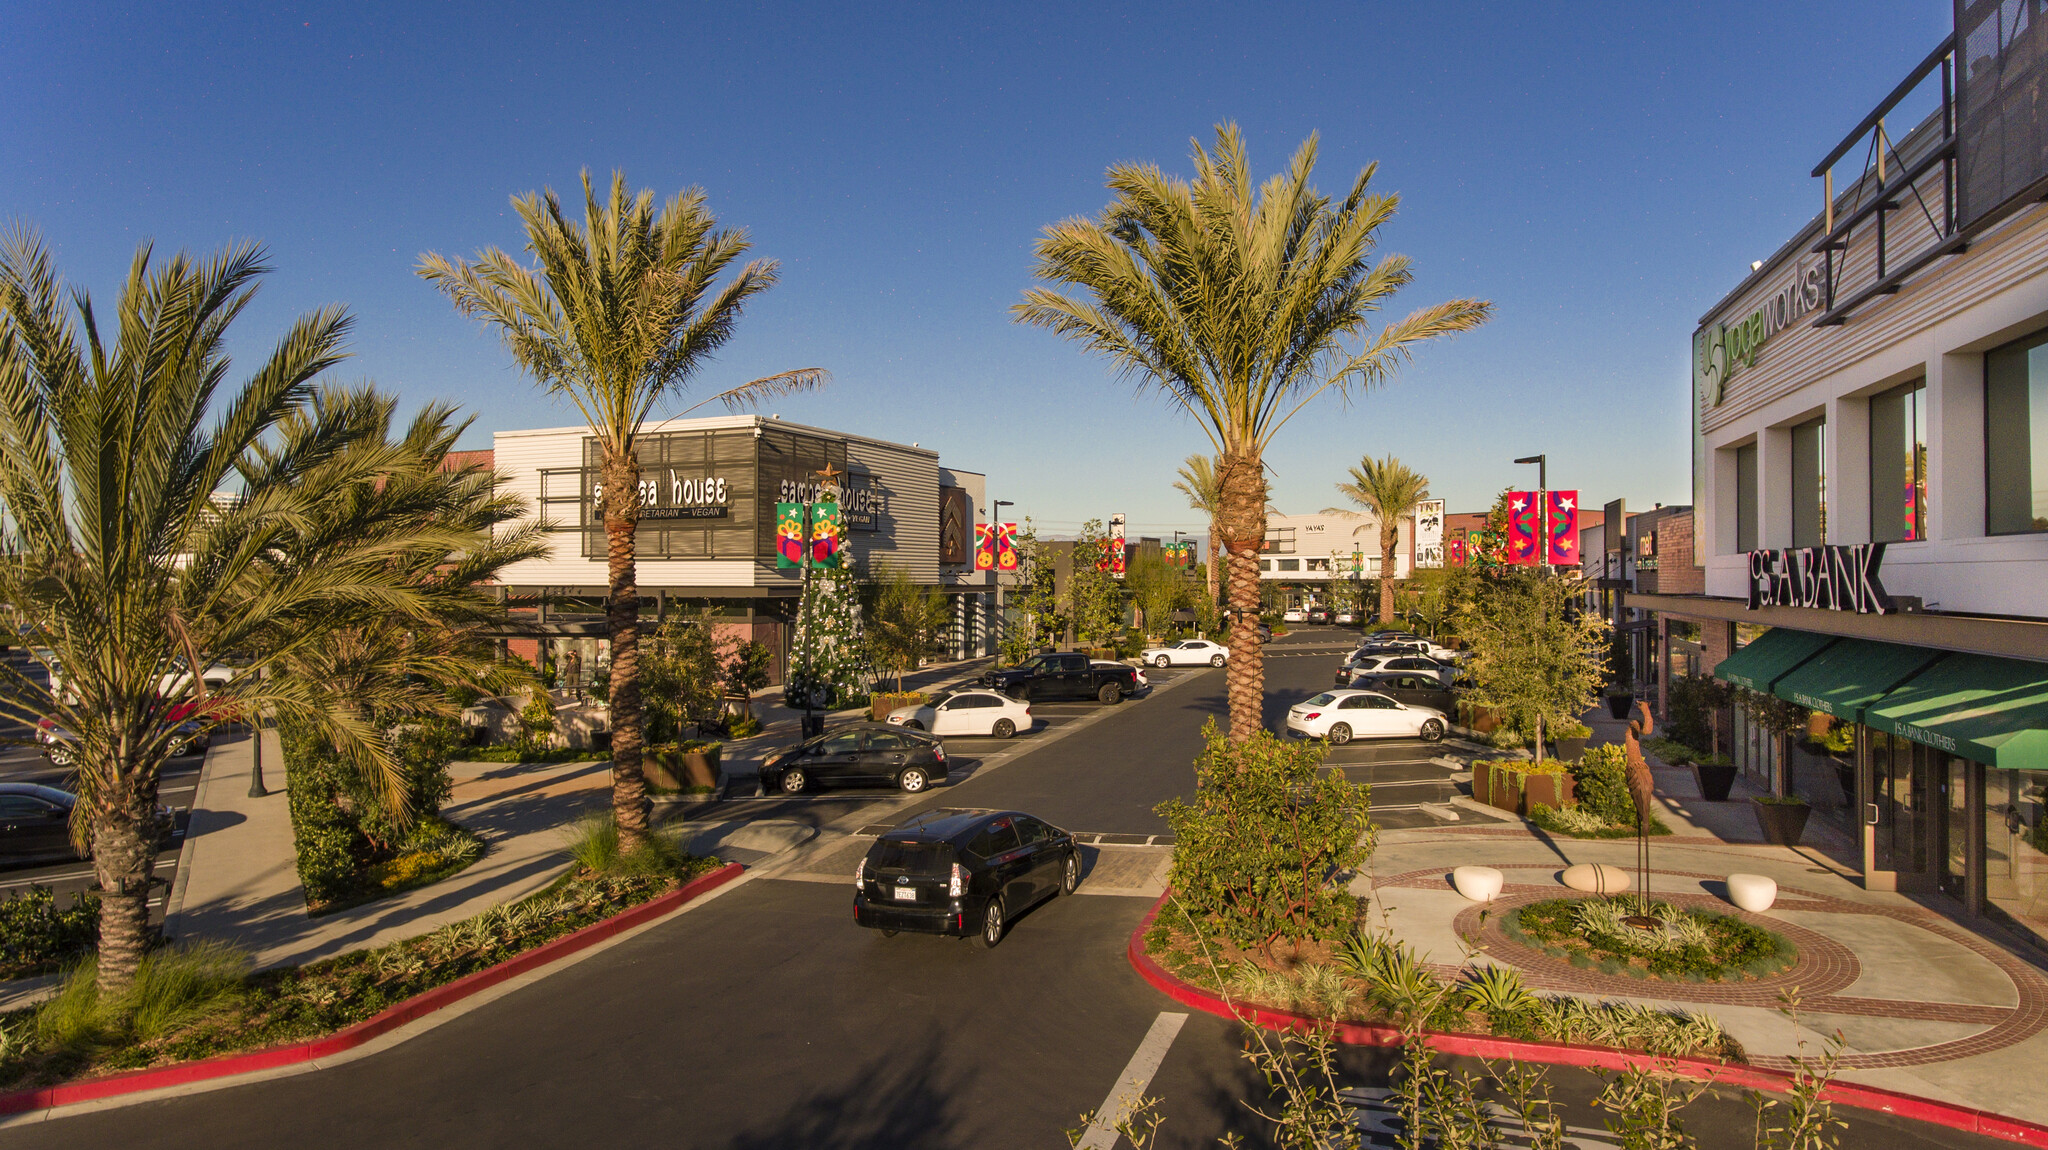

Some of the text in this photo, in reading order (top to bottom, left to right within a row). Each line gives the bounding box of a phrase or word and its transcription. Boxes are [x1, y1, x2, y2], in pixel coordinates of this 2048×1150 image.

[594, 468, 728, 507] ssa house
[691, 508, 721, 517] VEGAN
[1802, 543, 1885, 615] BANK
[1923, 729, 1957, 752] CLOTHIERS
